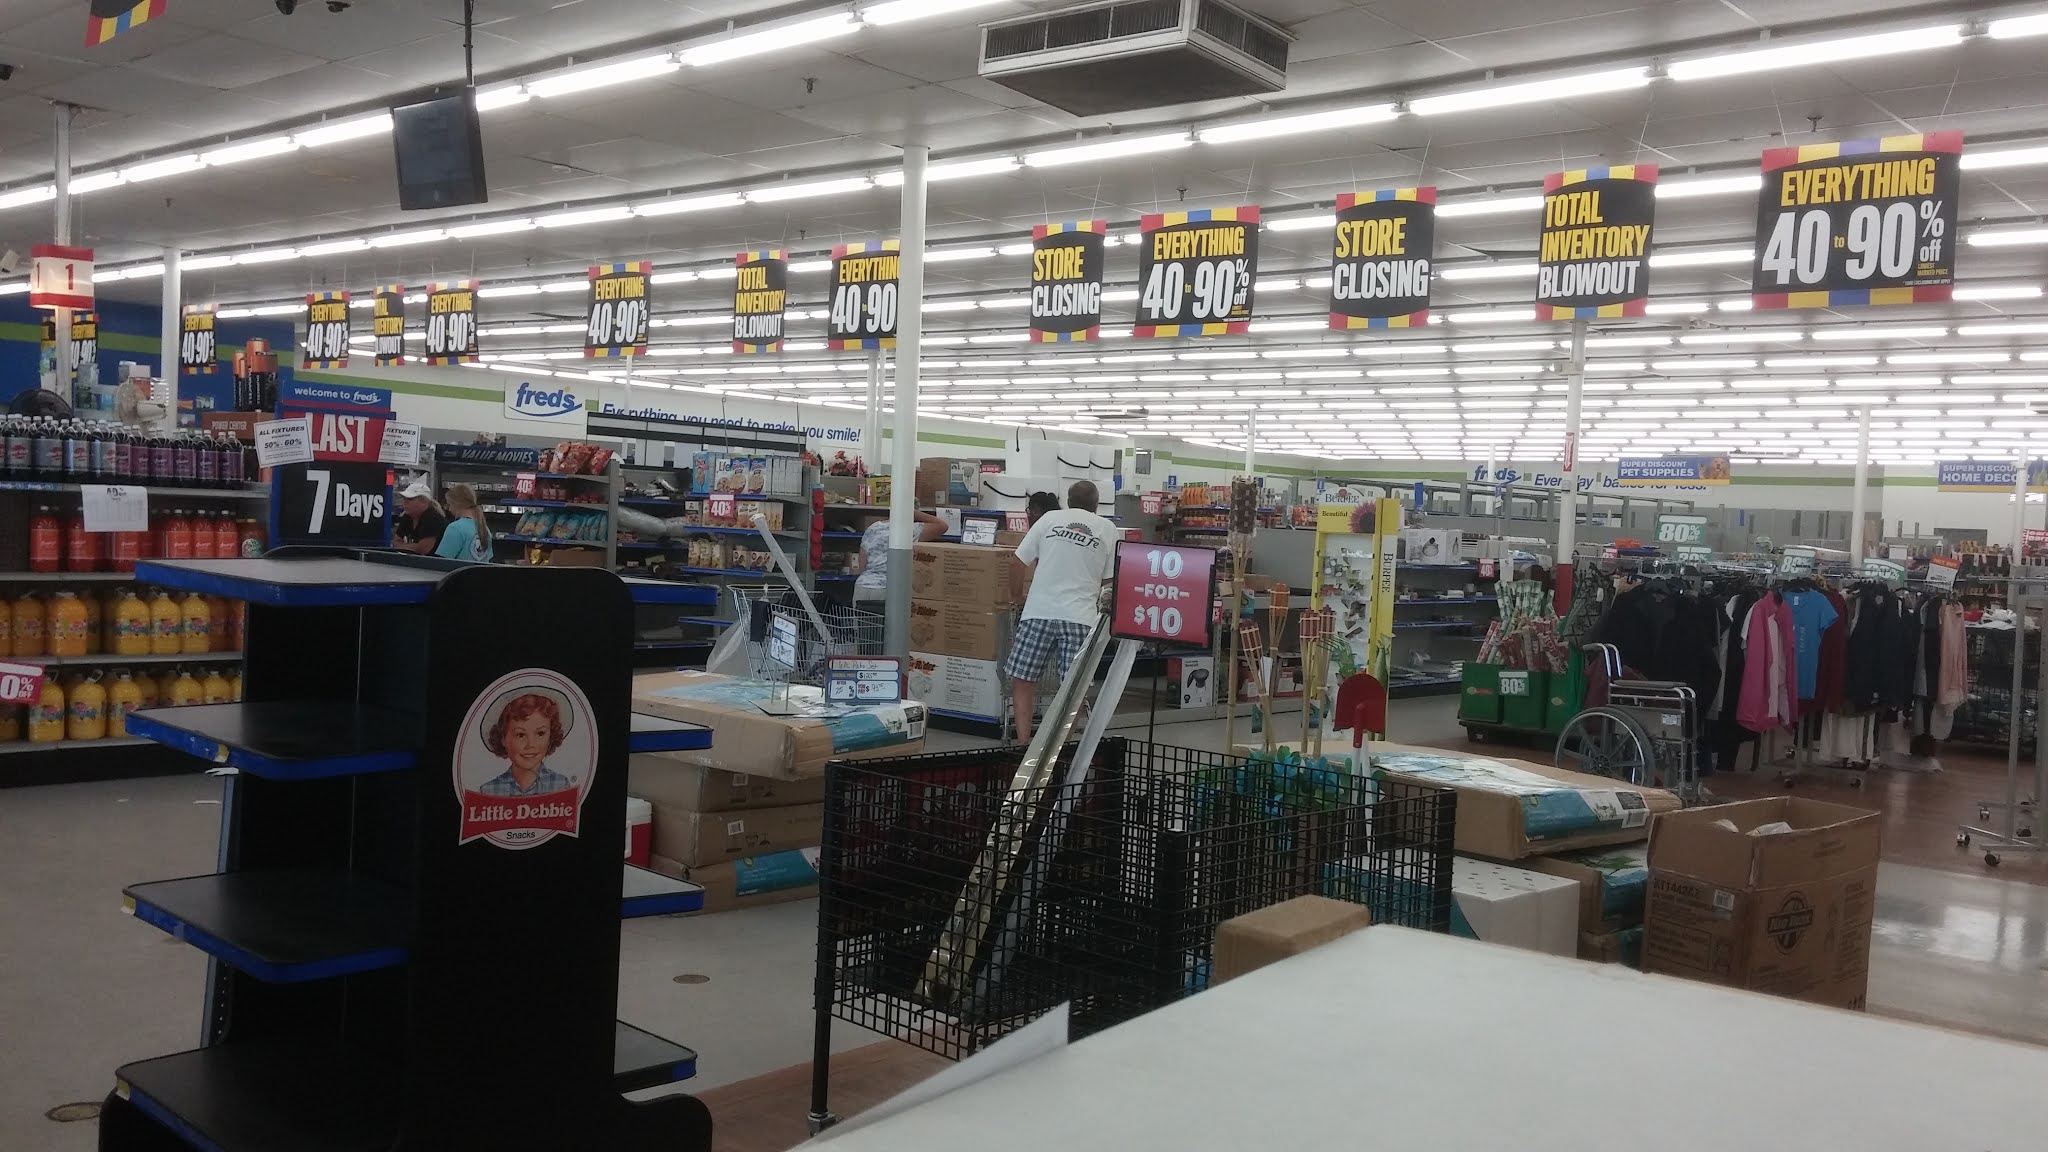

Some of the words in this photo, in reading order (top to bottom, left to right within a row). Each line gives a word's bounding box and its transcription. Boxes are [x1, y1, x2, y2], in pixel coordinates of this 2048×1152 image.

[1781, 157, 1935, 207] EVERYTHING
[1545, 191, 1603, 228] TOTAL
[1153, 226, 1244, 260] EVERYTHING
[1336, 218, 1406, 258] STORE
[1541, 224, 1650, 263] INVENTORY
[1762, 209, 1830, 285] 40
[1834, 235, 1845, 249] to
[65, 263, 75, 290] 1
[1033, 246, 1085, 282] STORE
[595, 278, 645, 301] EVERYTHING
[737, 267, 768, 290] TOTAL
[1142, 262, 1185, 320] 40
[1333, 259, 1429, 300] CLOSING
[1539, 261, 1640, 299] BLOWOUT
[311, 304, 346, 321] EVERYTHING
[431, 292, 472, 314] EVERYTHING
[735, 290, 786, 313] INVENTORY
[831, 284, 862, 333] 40
[1032, 282, 1100, 318] CLOSING
[185, 314, 213, 331] EVERYTHING
[588, 302, 611, 344] 40
[734, 313, 783, 339] BLOWOUT
[294, 387, 338, 399] welcome
[340, 391, 350, 399] to
[271, 426, 305, 435] FIXTURES
[304, 412, 369, 454] LAST
[802, 426, 824, 438] you
[826, 428, 861, 442] smile!
[264, 441, 280, 449] 50%
[496, 450, 533, 463] MOVIES
[718, 461, 730, 472] Life
[1621, 468, 1640, 477] PET
[1642, 468, 1694, 477] SUPPLIES
[1942, 473, 1981, 482] HOME
[1943, 464, 1975, 472] SUPER
[306, 470, 330, 533] 7
[336, 483, 383, 524] Days
[1046, 526, 1086, 542] Santa
[1146, 550, 1183, 579] 10
[1382, 552, 1394, 593] BURPEE
[1134, 605, 1183, 636] $10
[468, 804, 514, 822] Little
[516, 802, 573, 820] Debbie
[506, 831, 535, 840] Snacks
